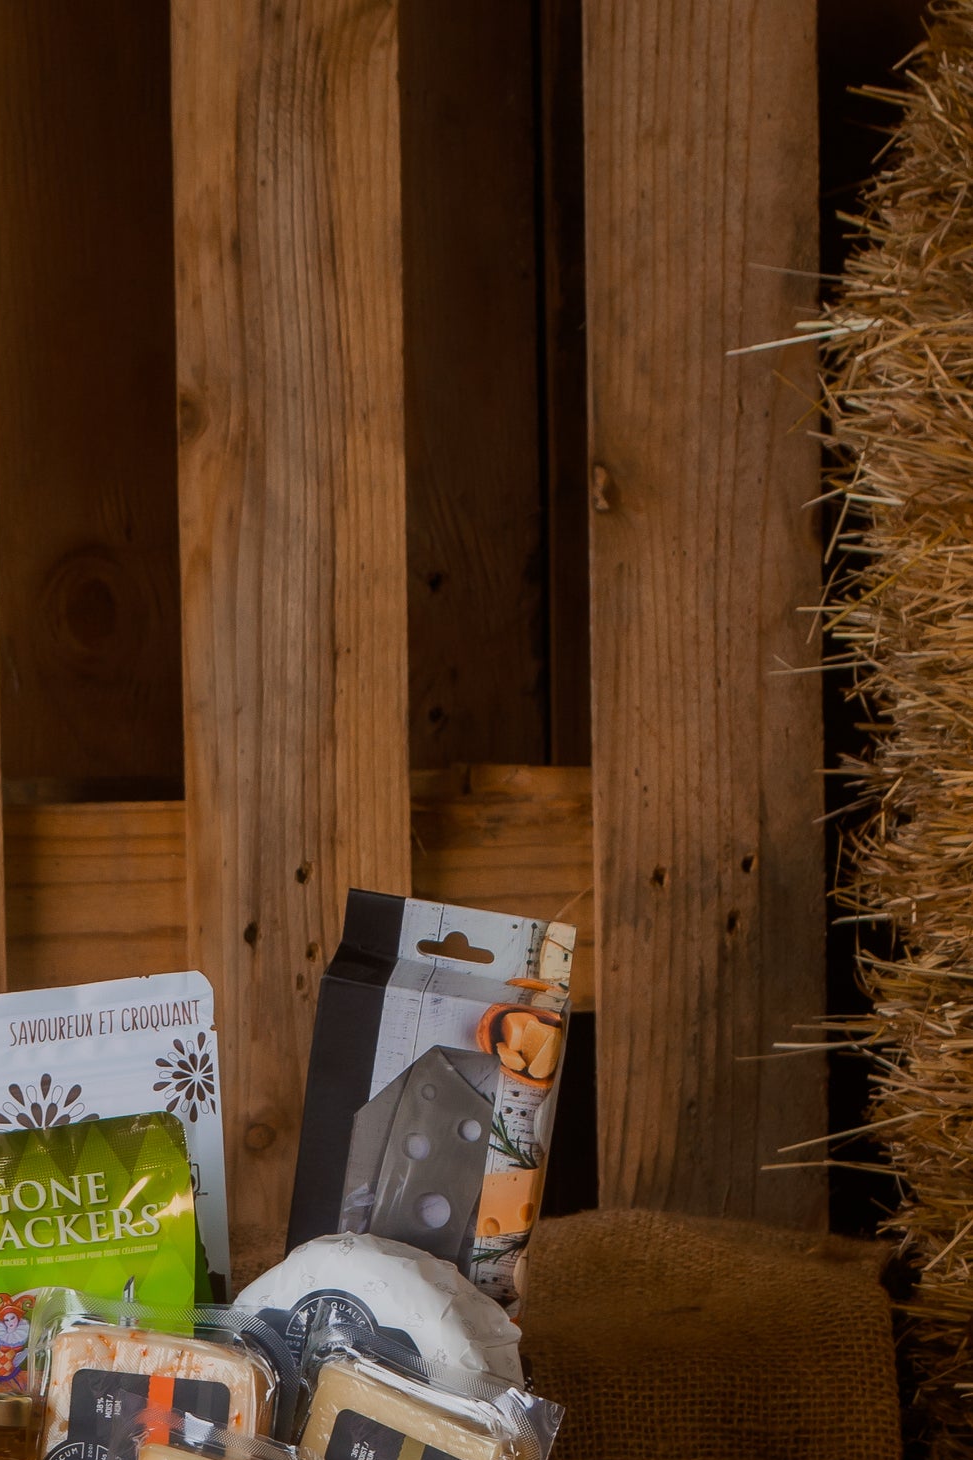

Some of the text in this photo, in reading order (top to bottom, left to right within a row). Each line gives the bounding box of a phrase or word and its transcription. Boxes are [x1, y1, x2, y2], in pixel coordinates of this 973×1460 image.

[10, 1000, 201, 1047] SAVOUREUX ET CROQUANT
[330, 1301, 367, 1329] QUALIC
